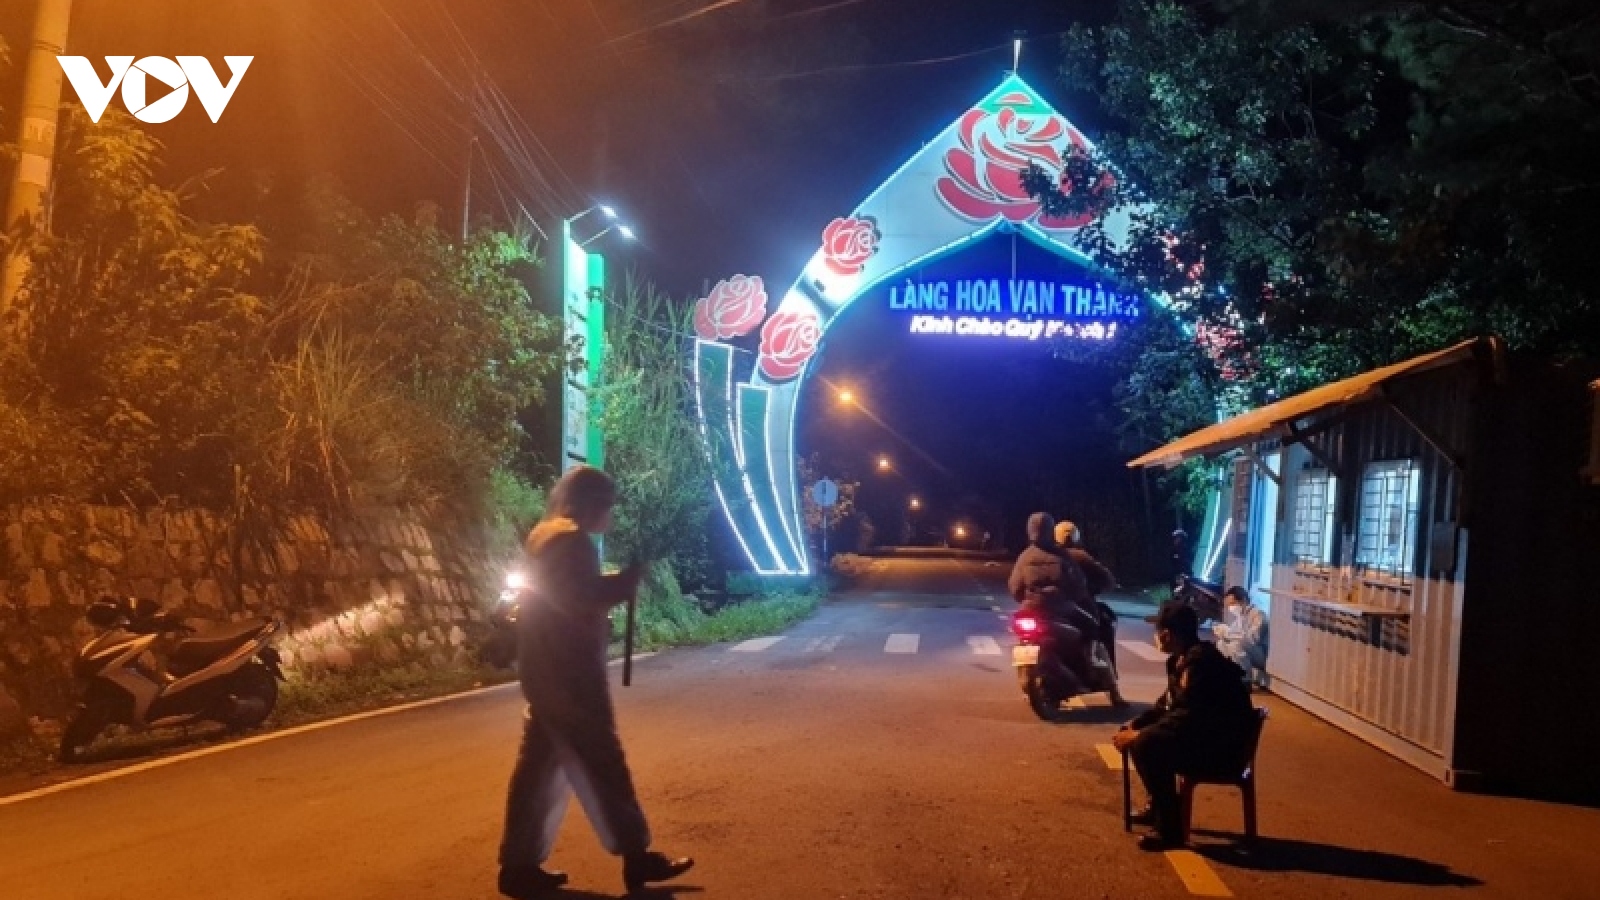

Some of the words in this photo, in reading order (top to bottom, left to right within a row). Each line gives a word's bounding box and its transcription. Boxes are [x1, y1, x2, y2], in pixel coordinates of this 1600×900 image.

[890, 278, 948, 311] LÀNG
[956, 278, 1002, 312] HOA
[1008, 279, 1055, 320] VẠN
